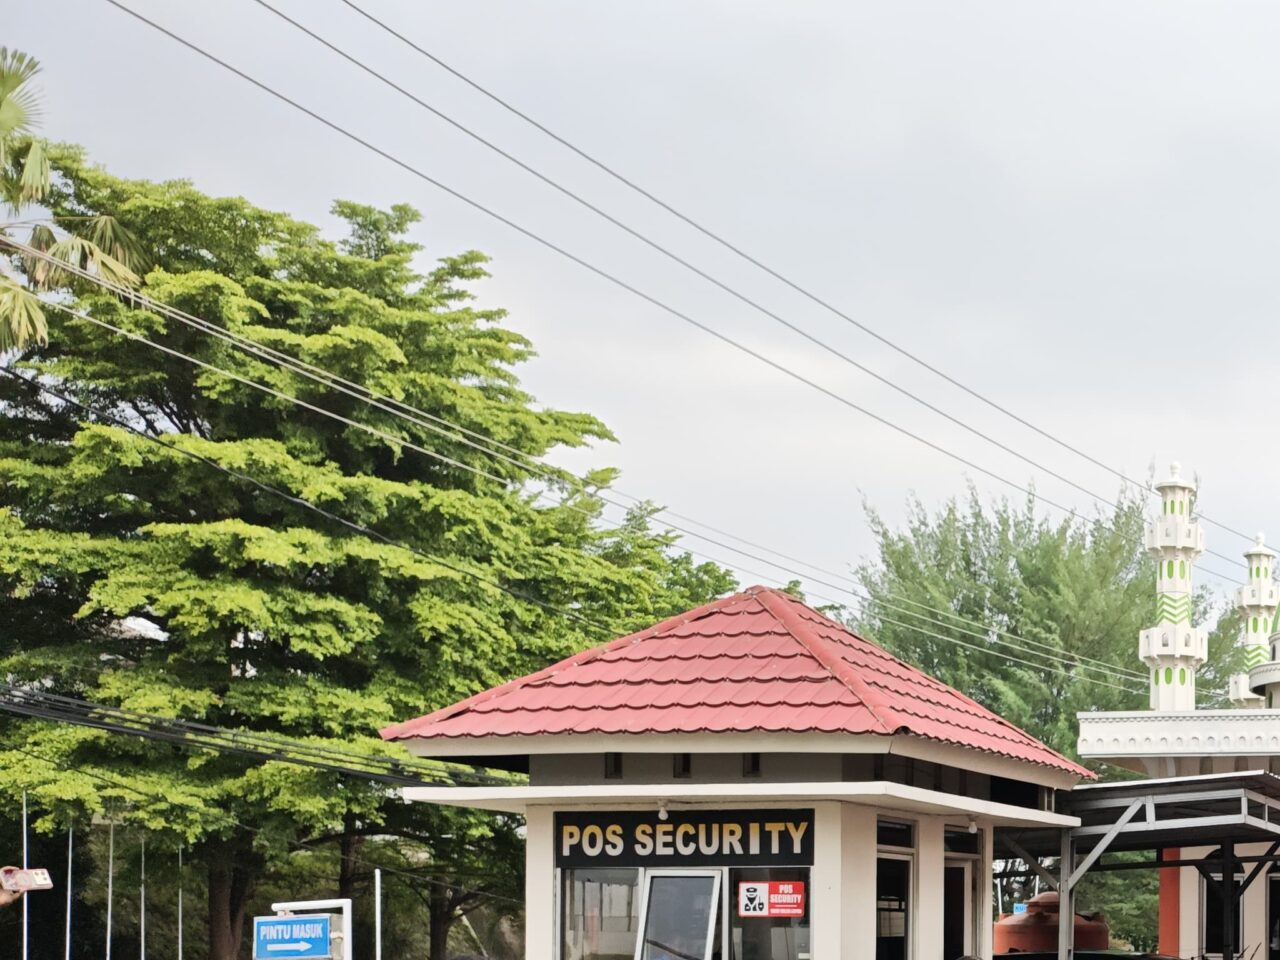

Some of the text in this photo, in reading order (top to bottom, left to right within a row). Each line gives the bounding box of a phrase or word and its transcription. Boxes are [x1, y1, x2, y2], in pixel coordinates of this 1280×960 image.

[562, 822, 808, 857] POS SECURITY
[778, 884, 793, 893] POS
[769, 893, 802, 904] SECURITY
[260, 923, 323, 940] PINTU MASUK
